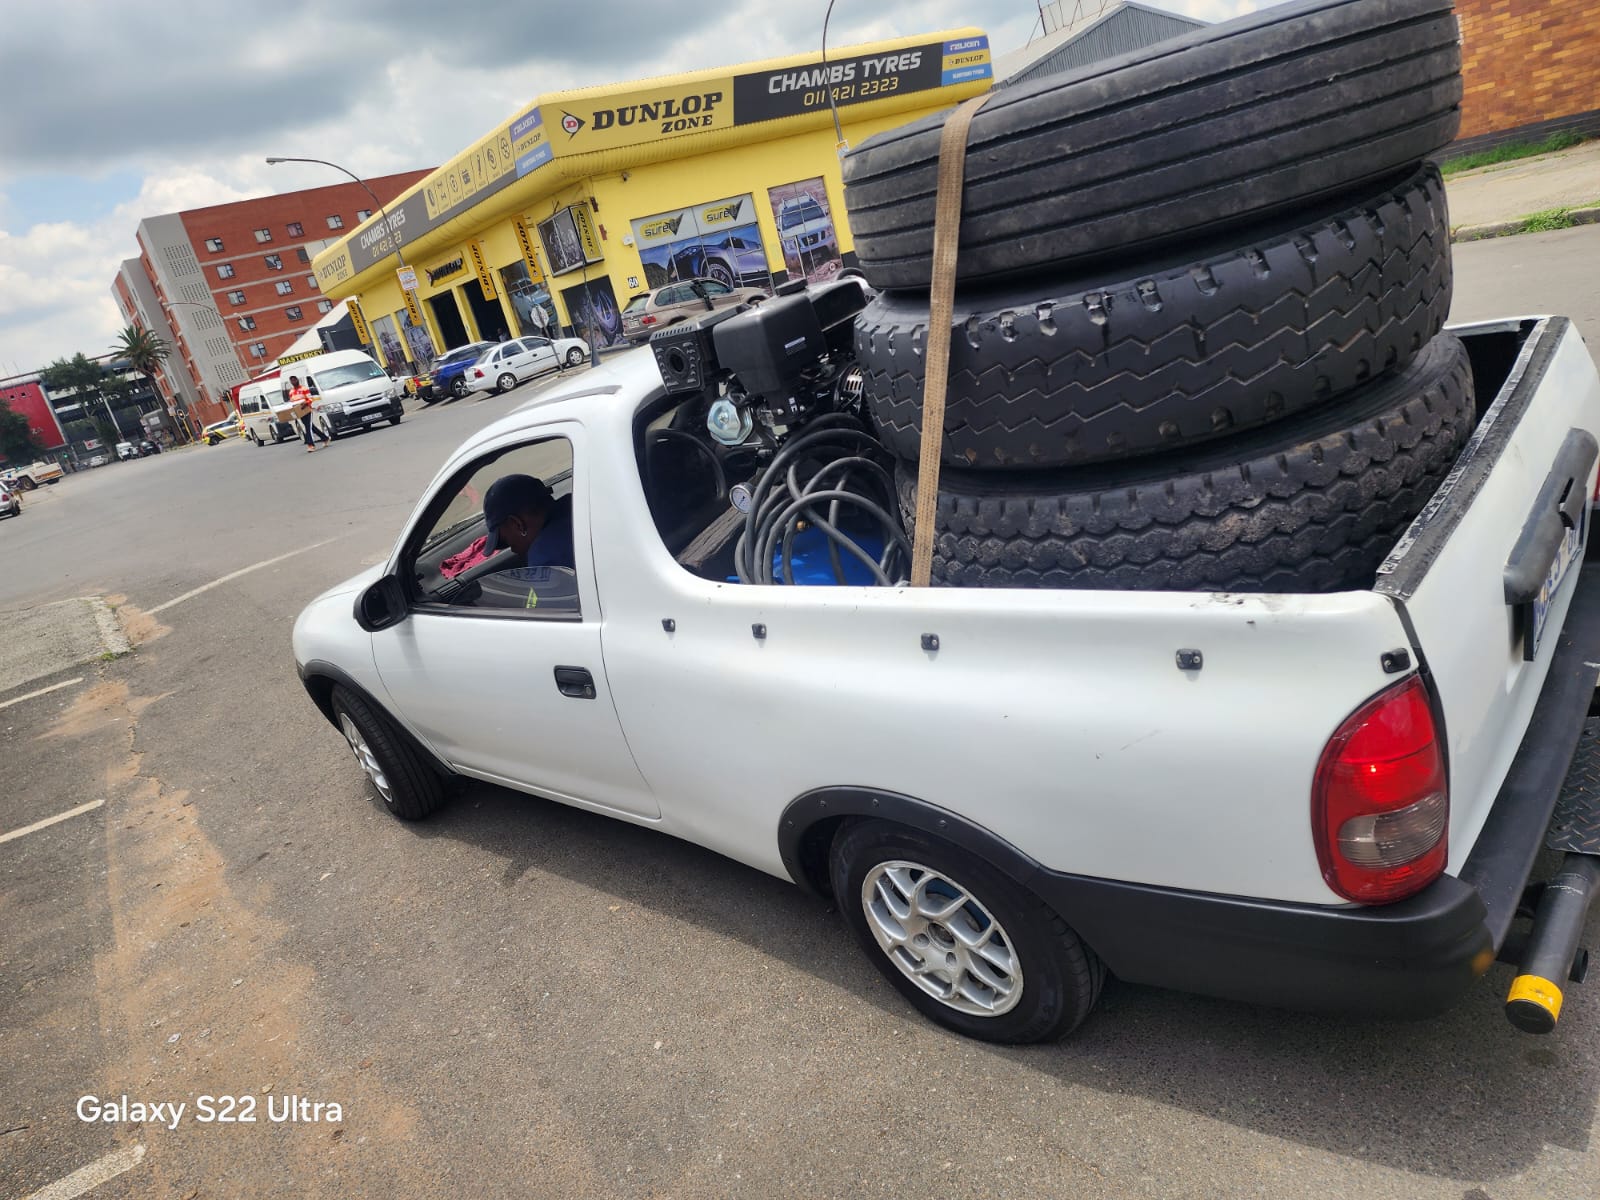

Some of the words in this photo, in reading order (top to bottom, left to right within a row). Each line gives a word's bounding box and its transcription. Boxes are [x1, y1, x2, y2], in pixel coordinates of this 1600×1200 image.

[768, 62, 857, 94] CHAMBS
[862, 51, 922, 78] TYRES
[955, 54, 984, 64] DUNLOP
[803, 90, 825, 107] 011
[831, 84, 855, 101] 421
[860, 77, 899, 96] 2323
[592, 91, 723, 131] DUNLOP
[661, 115, 713, 134] ZONE
[360, 222, 386, 249] CHAMBS
[578, 210, 593, 247] DUNLOP
[517, 222, 535, 267] DUNLOP
[322, 254, 346, 279] DUNLOP
[472, 244, 489, 286] DUNLOP
[628, 277, 639, 288] 60
[279, 349, 324, 366] MASTERKEY
